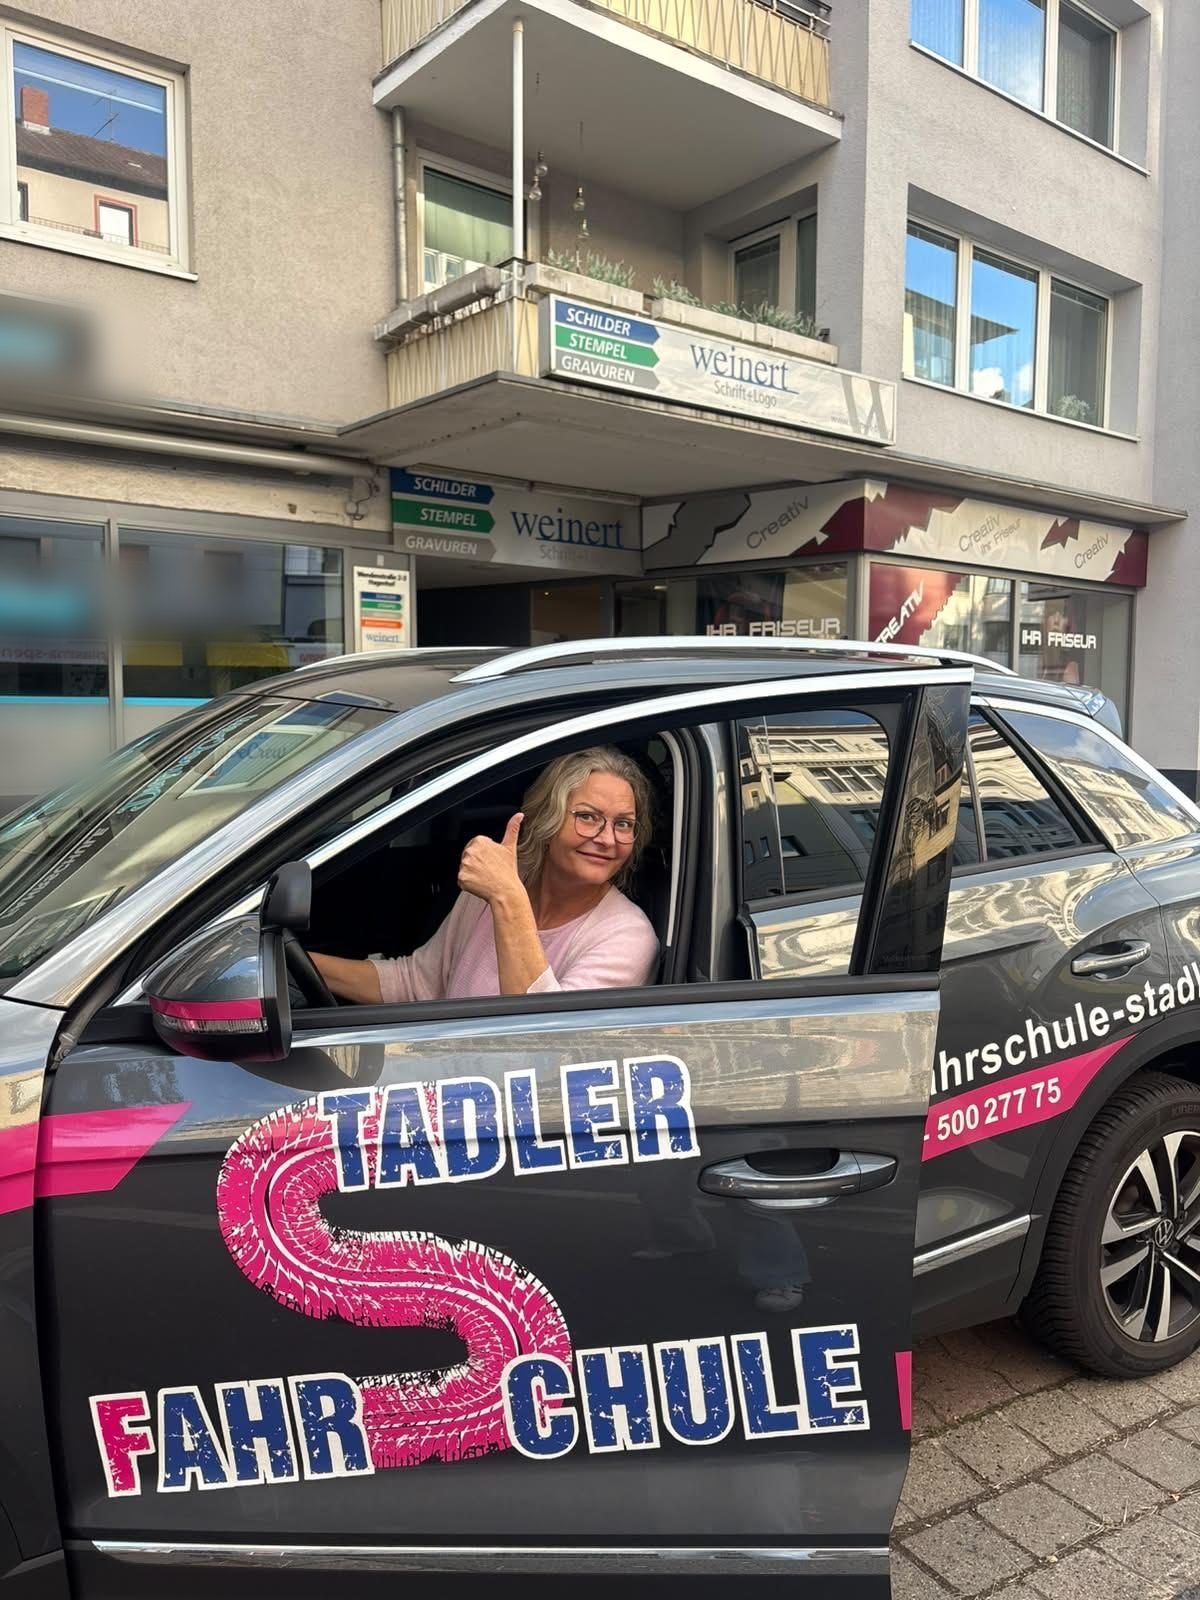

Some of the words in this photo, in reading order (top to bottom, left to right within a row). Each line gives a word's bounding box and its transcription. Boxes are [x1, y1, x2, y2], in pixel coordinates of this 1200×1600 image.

[566, 307, 631, 336] SCHILDER
[569, 333, 628, 359] STEMPEL
[560, 356, 635, 384] GRAVUREN
[689, 344, 790, 391] weinert
[414, 477, 477, 498] SCHILDER
[420, 507, 478, 527] STEMPEL
[511, 507, 625, 549] weinert
[746, 496, 809, 549] Creativ
[405, 535, 478, 556] GRAVUREN
[958, 511, 1001, 553] Creativ
[1074, 532, 1111, 570] Creativ
[875, 579, 924, 643] REATIV
[750, 618, 841, 637] FRISEUR
[1021, 630, 1042, 646] IHR
[1048, 632, 1097, 649] FRISEUR
[937, 1104, 979, 1141] 500
[985, 1087, 1027, 1125] 277
[1032, 1077, 1062, 1108] 75
